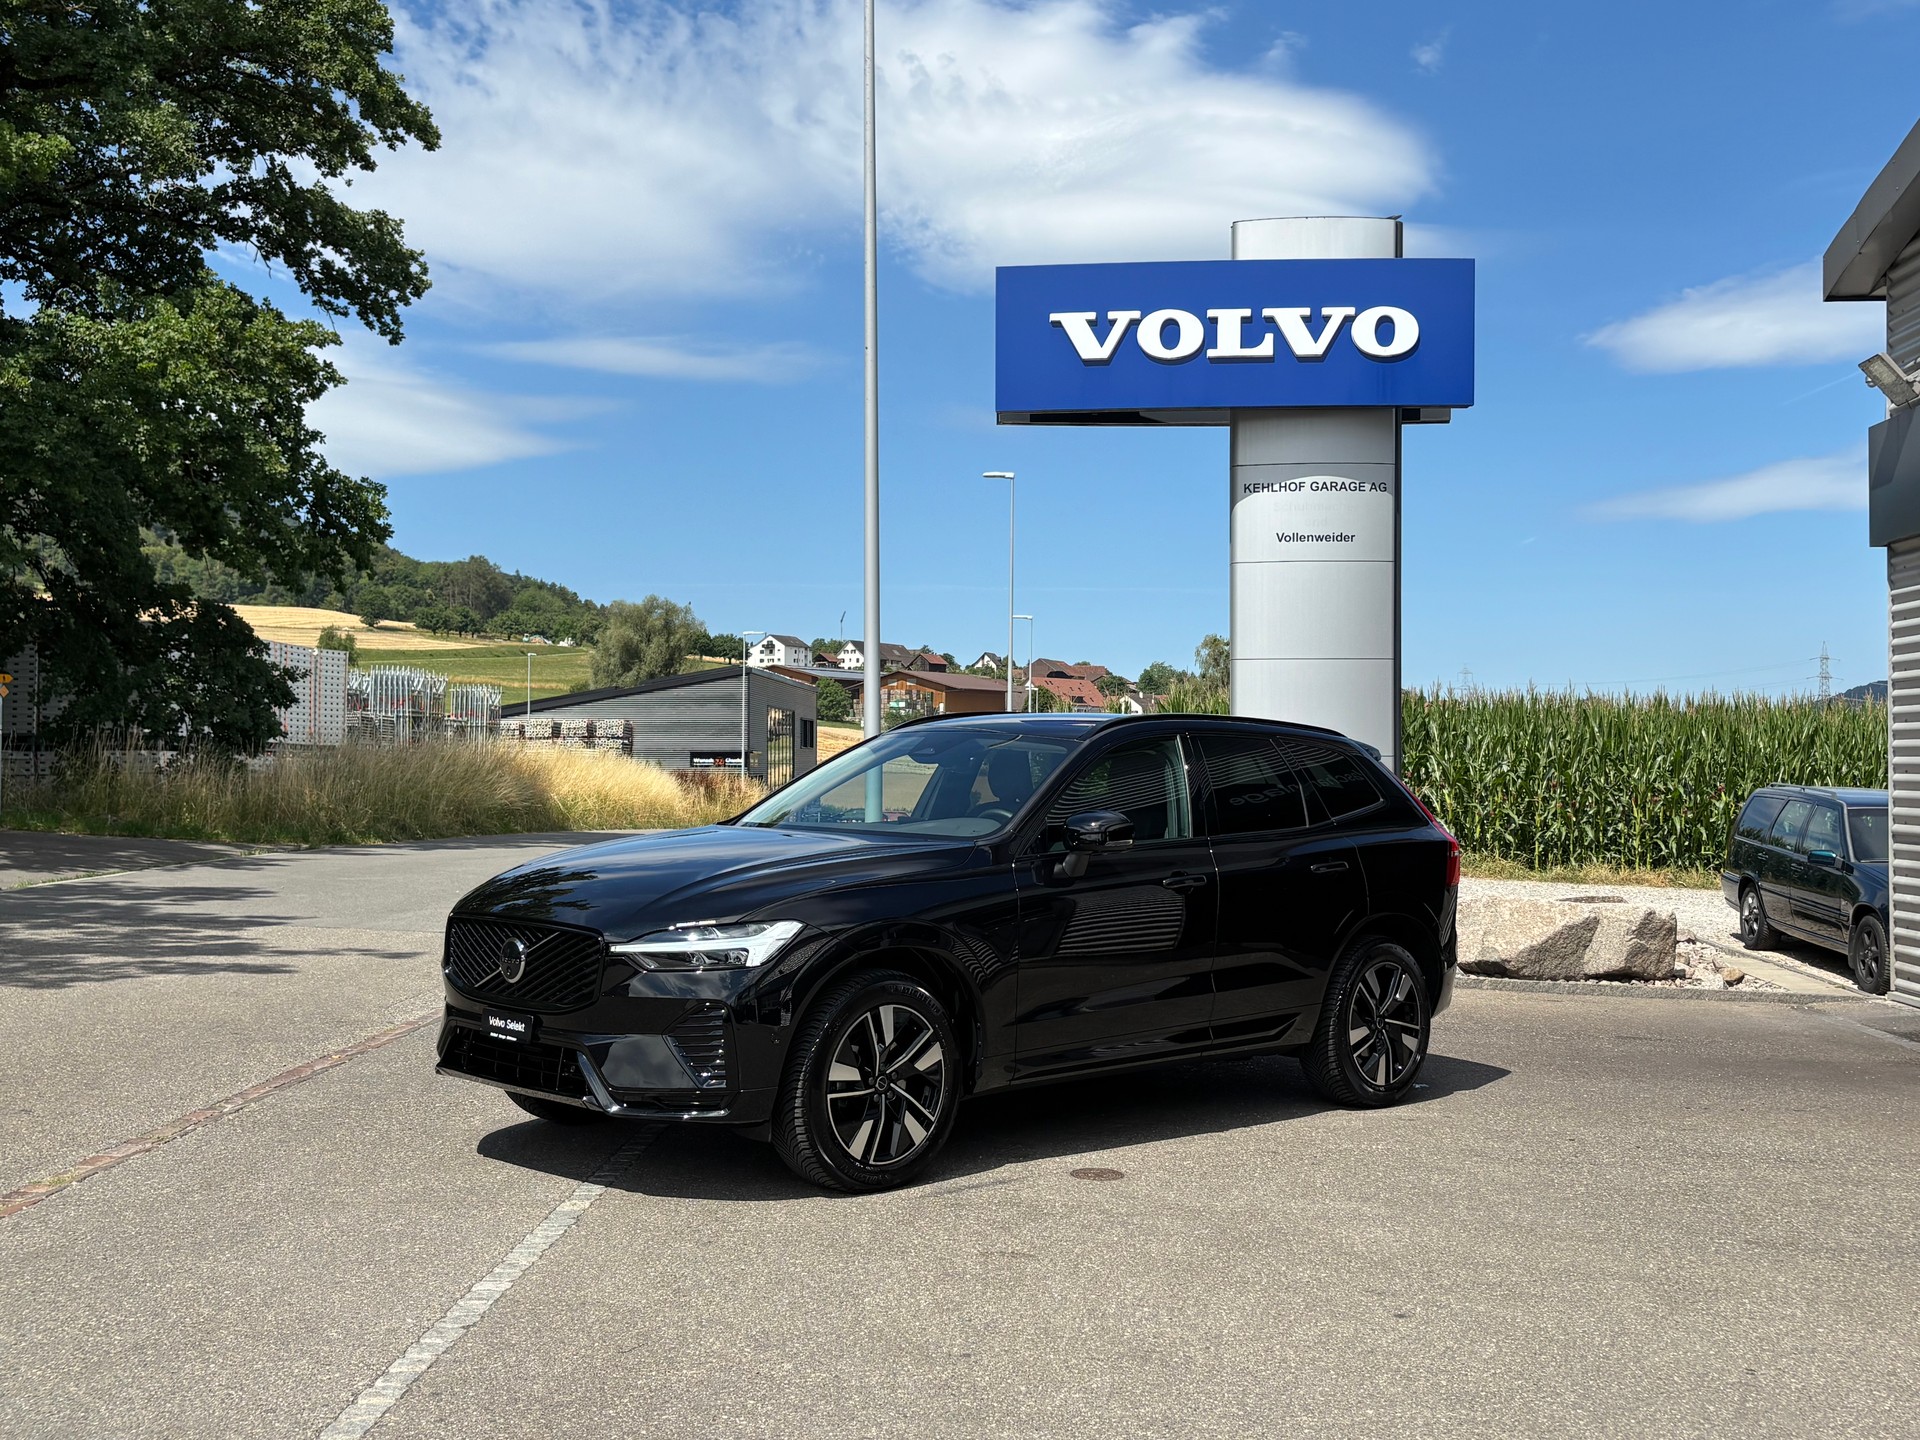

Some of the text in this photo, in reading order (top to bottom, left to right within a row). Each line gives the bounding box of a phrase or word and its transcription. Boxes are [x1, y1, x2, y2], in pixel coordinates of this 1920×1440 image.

[1049, 305, 1420, 360] VOLVO
[1243, 481, 1388, 494] KEHLHOF GARAGE AG
[1276, 532, 1356, 543] Vollenweider
[488, 1015, 526, 1033] Volvo Selekt
